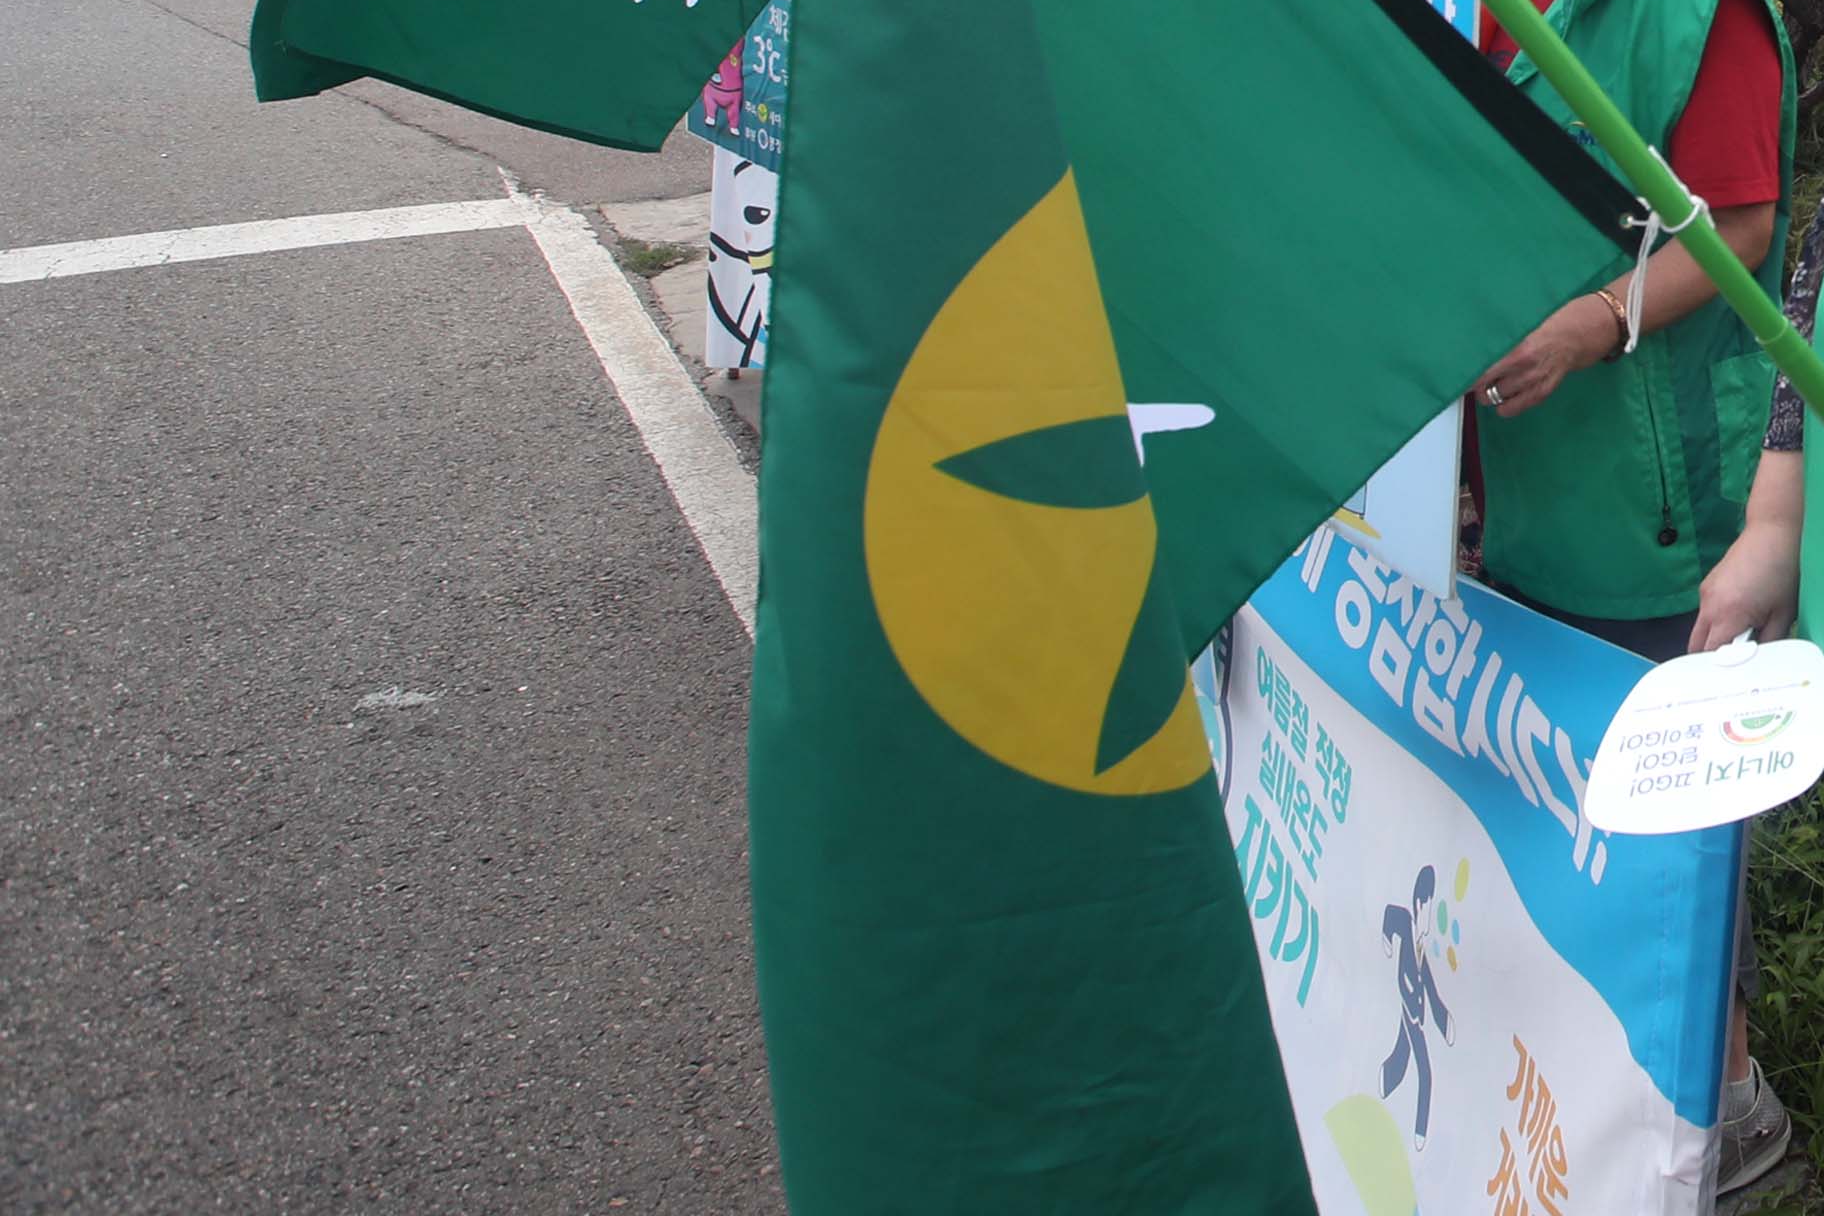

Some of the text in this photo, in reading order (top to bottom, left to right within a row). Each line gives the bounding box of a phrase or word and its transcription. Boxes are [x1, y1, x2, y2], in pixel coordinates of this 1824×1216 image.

[1256, 645, 1352, 825] 여름철 적정
[1258, 730, 1328, 883] 실내온도
[1705, 750, 1795, 785] 에너지
[1234, 792, 1321, 1009] 지키기
